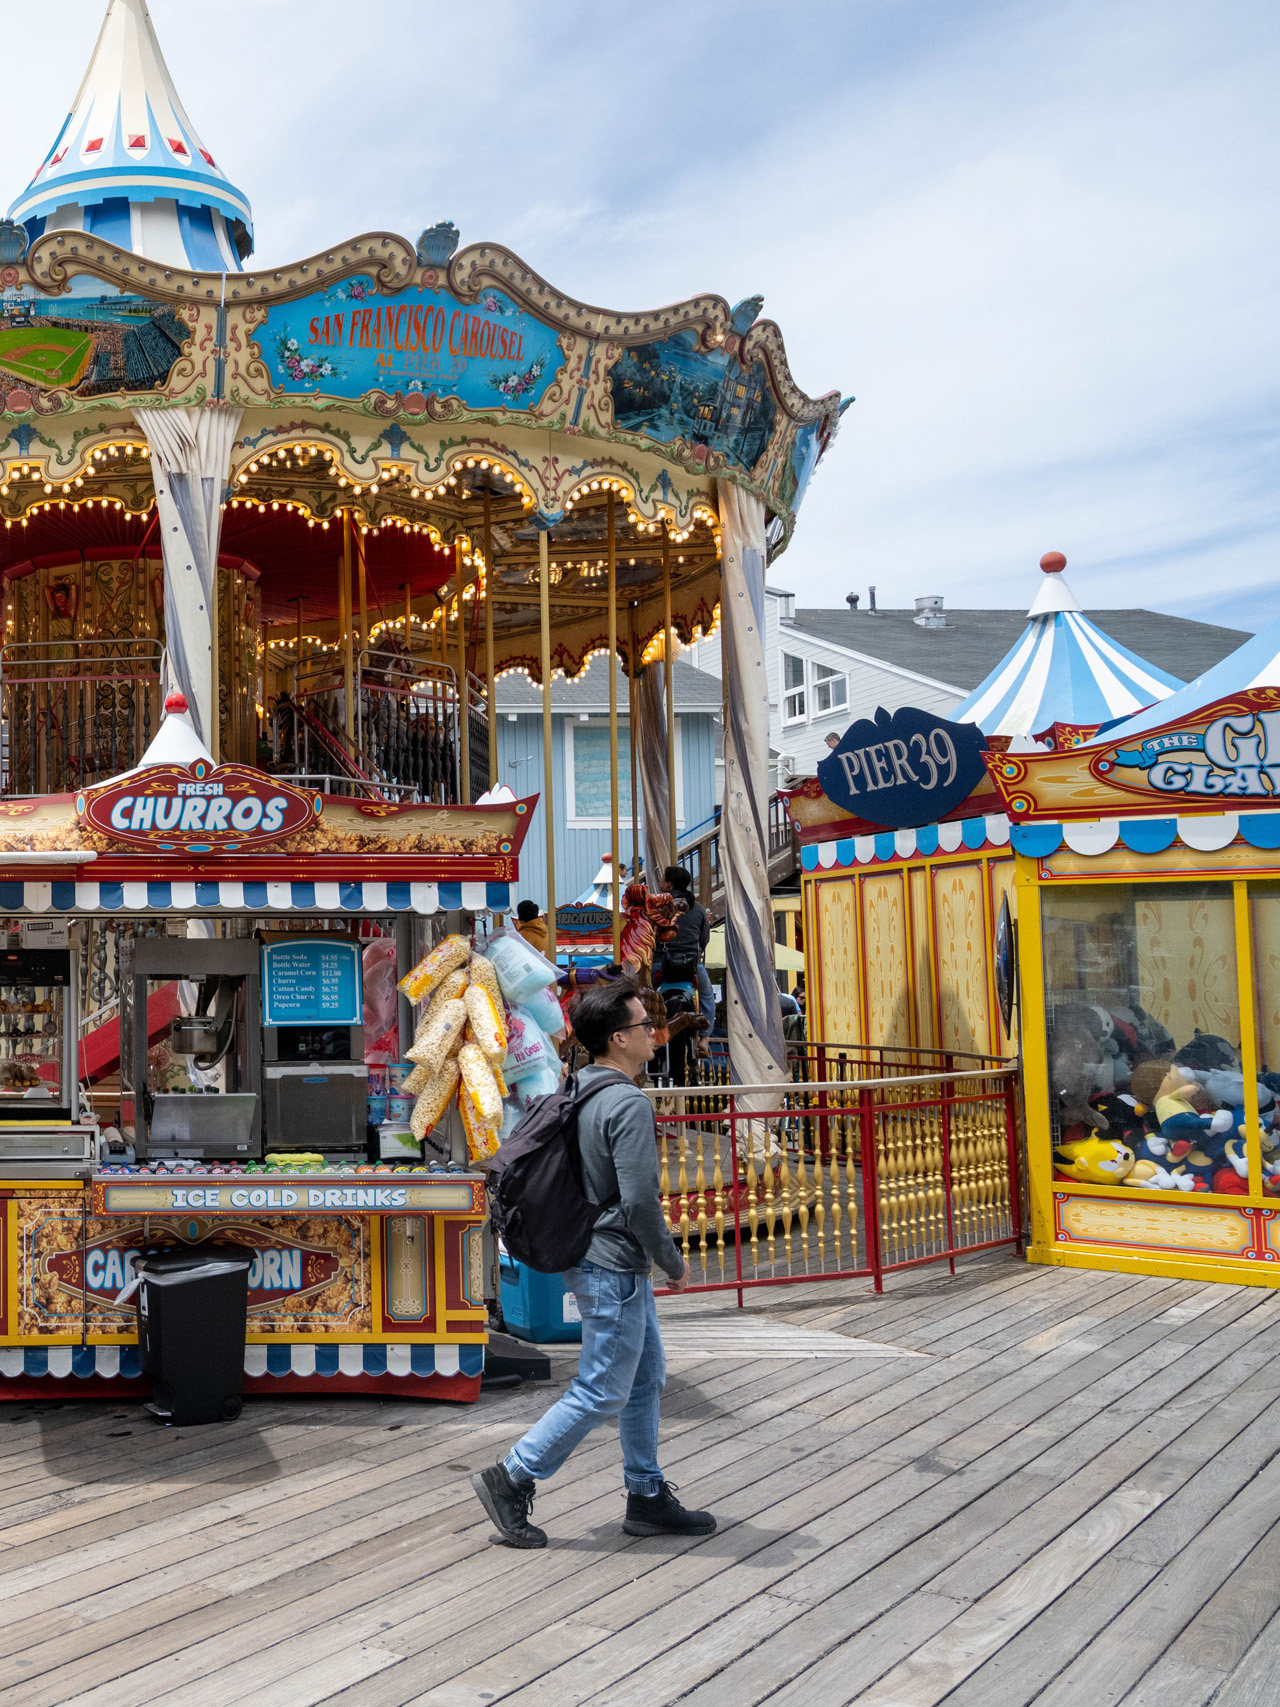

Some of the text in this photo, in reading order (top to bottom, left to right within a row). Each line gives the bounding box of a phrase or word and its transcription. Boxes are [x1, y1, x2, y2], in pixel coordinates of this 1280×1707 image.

[308, 304, 524, 361] SAN FRANCISCO CAROUSEL
[374, 353, 467, 373] At PIER 39
[1146, 735, 1198, 751] THE
[837, 727, 958, 796] PIER 39
[177, 782, 224, 796] FRESH
[1149, 762, 1280, 796] CLA
[110, 796, 289, 832] CHURROS
[556, 911, 613, 926] ARICATURES
[524, 1041, 543, 1056] Great
[172, 1189, 407, 1207] ICE COLD DRINKS
[248, 1248, 302, 1291] ORN
